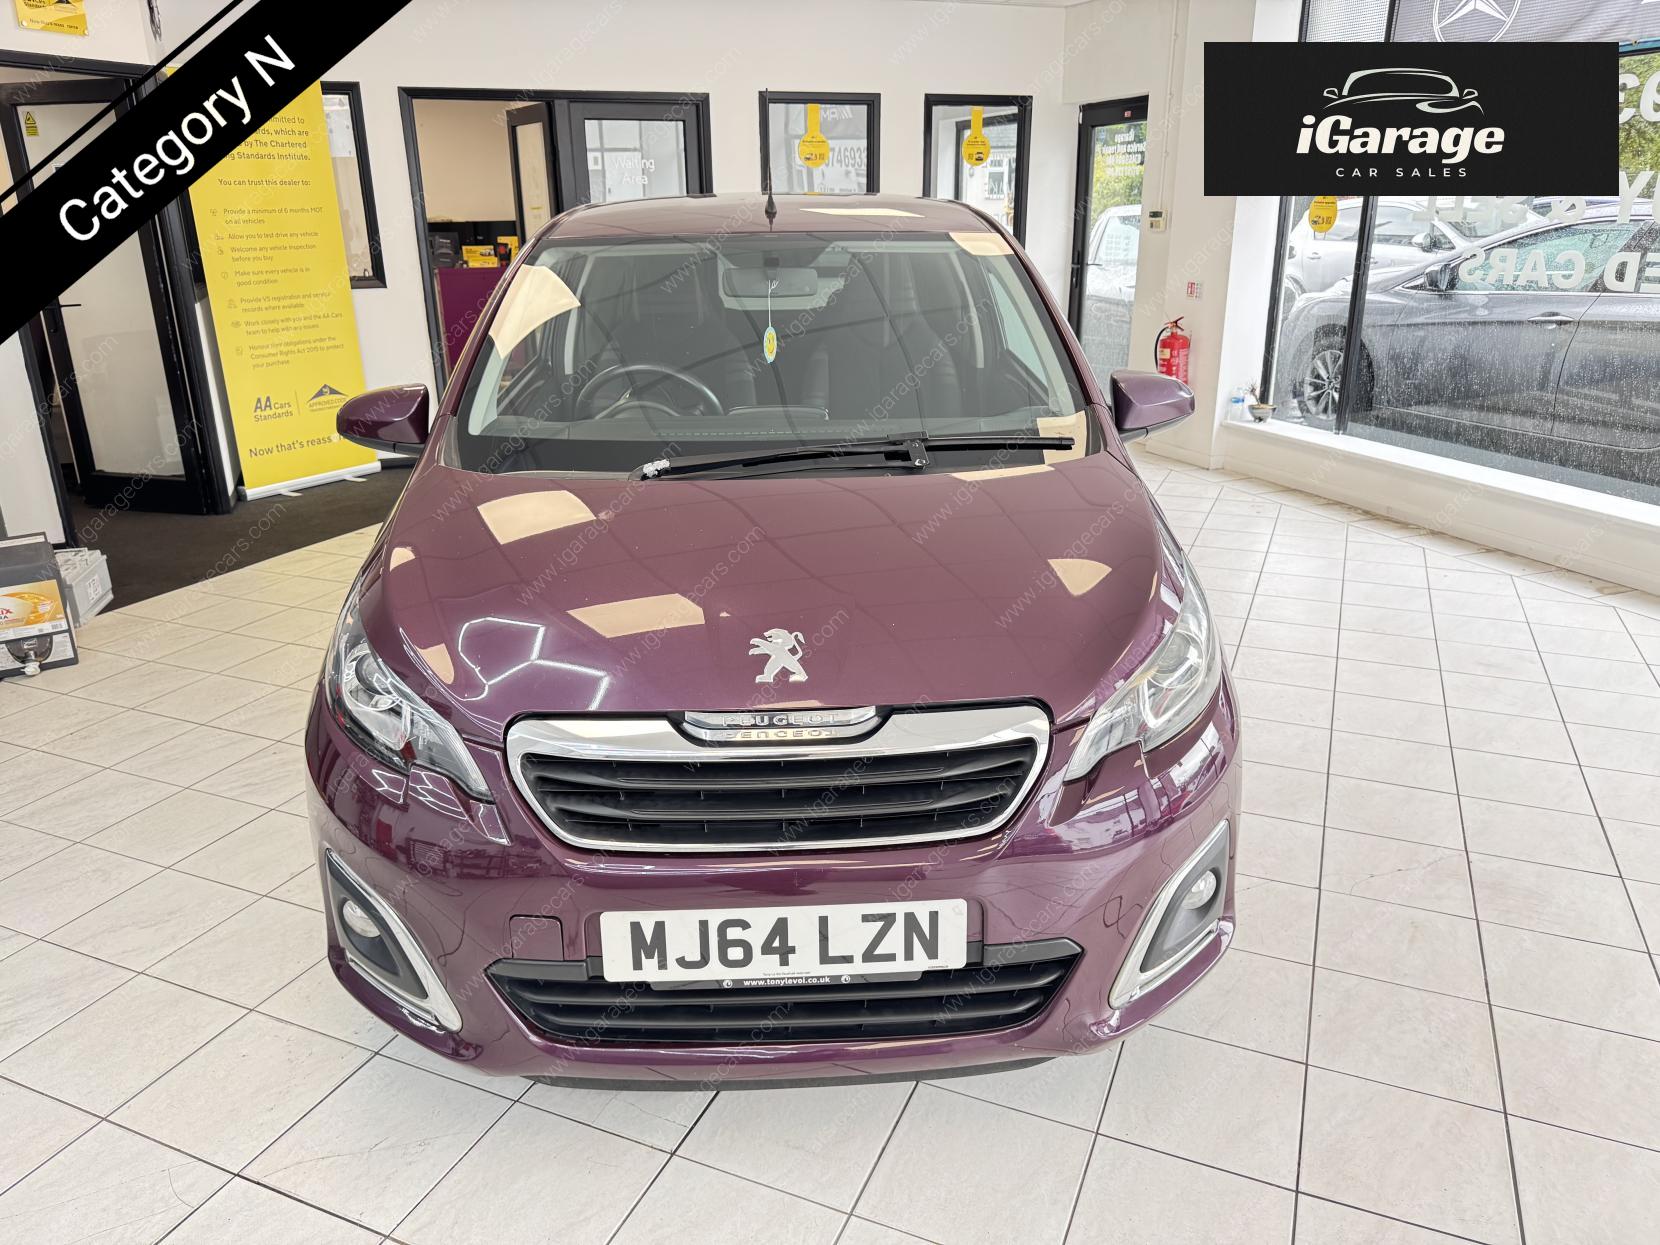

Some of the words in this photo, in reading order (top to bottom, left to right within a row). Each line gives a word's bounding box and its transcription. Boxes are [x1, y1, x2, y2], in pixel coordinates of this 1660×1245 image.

[274, 128, 296, 136] which
[298, 129, 309, 137] are
[255, 140, 266, 148] The
[270, 140, 307, 149] Chartered
[237, 152, 276, 160] Standards
[277, 153, 311, 161] Institute.
[615, 156, 655, 172] Waiting
[622, 174, 648, 184] Area
[254, 395, 272, 413] AA
[273, 401, 292, 410] Cars
[254, 410, 293, 422] Standards
[249, 446, 274, 458] Now
[276, 440, 304, 453] that's
[722, 713, 839, 727] PEUGEOT
[629, 917, 797, 971] MJ64
[818, 910, 939, 965] LZN
